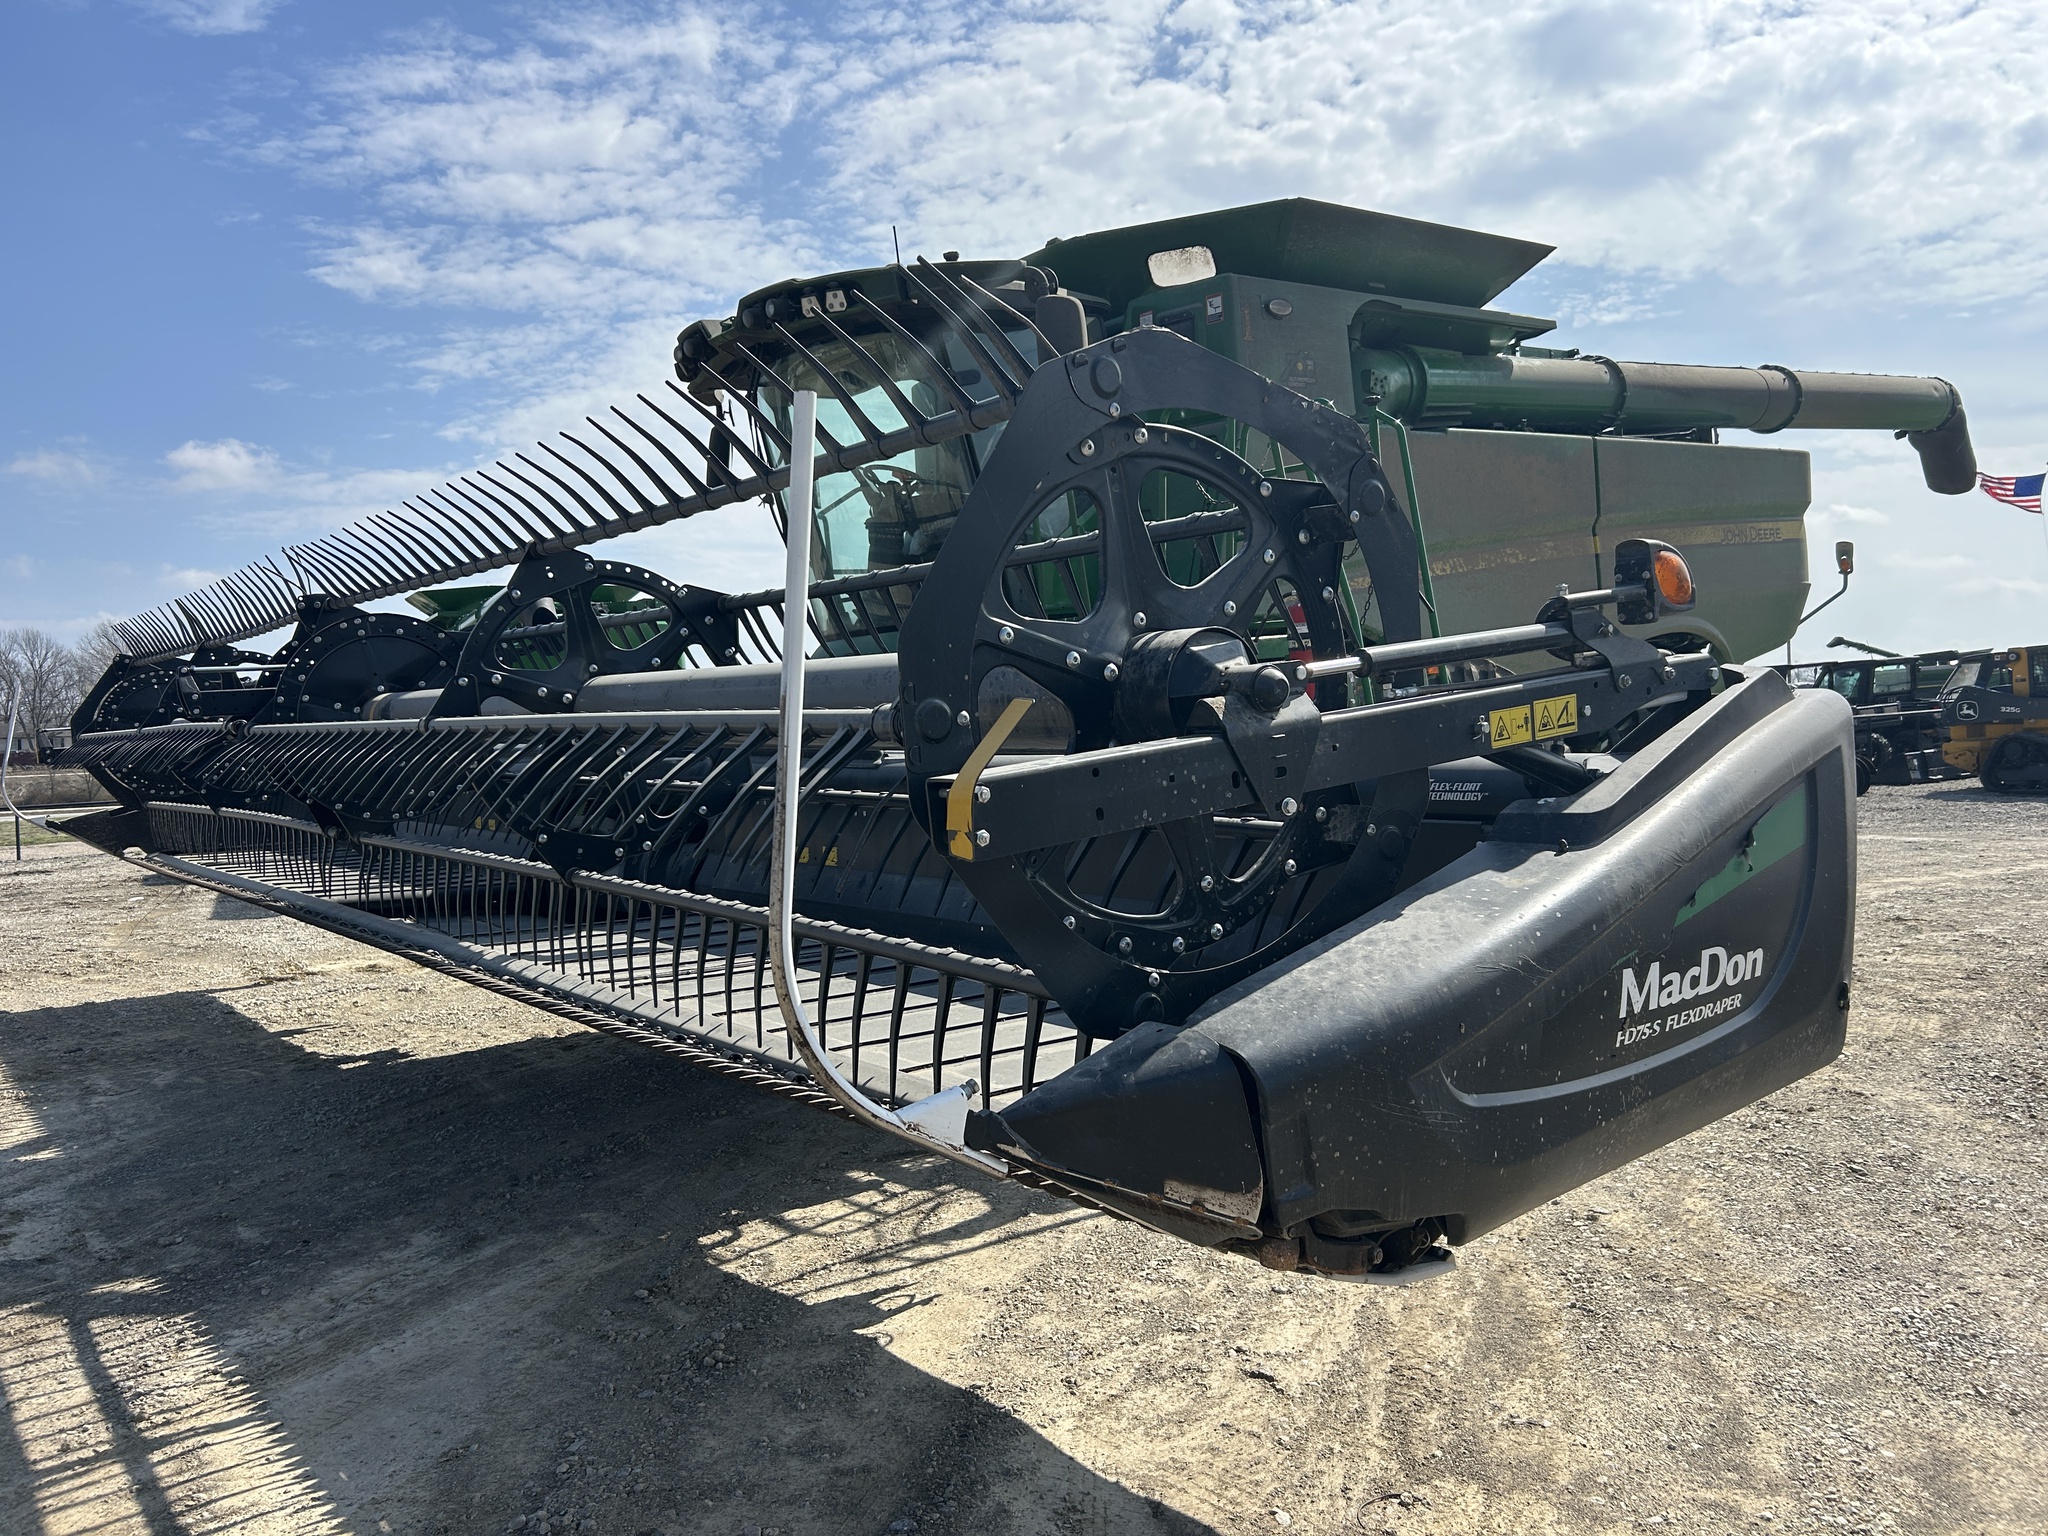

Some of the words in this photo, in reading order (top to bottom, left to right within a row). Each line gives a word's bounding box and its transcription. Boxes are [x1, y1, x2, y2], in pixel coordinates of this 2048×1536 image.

[1721, 527, 1748, 543] JOHN
[1750, 526, 1782, 541] DEERE
[1429, 782, 1483, 791] FLEX-FLOAT
[1619, 946, 1764, 1019] MacDon
[1615, 1019, 1662, 1048] FD75-S
[1665, 993, 1742, 1032] FLEXDRAPER
